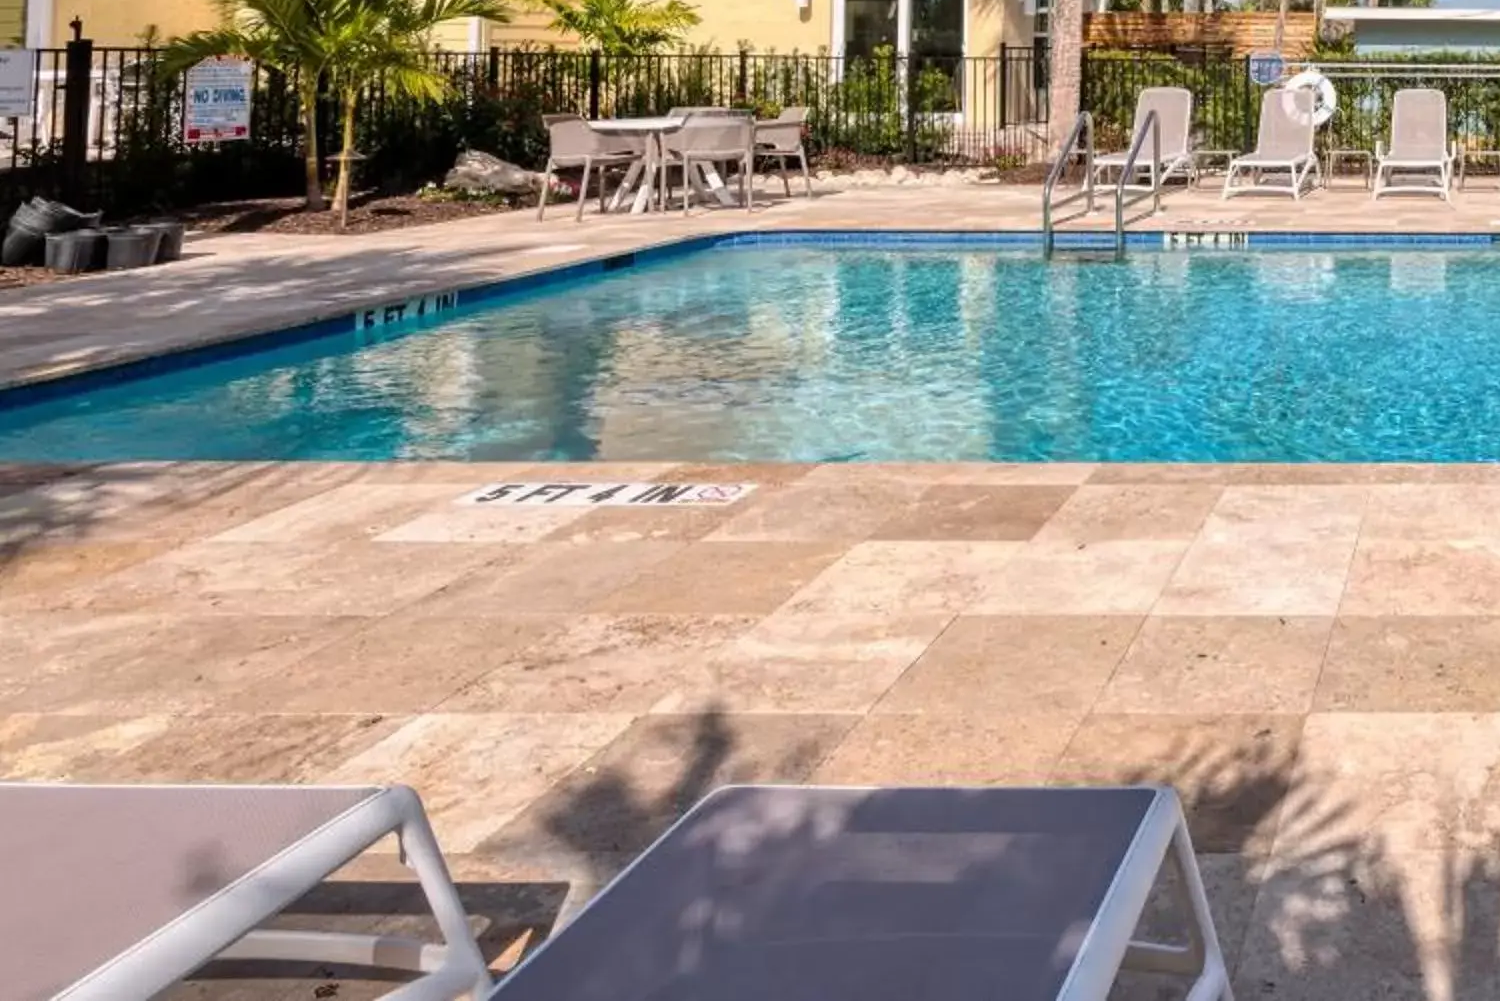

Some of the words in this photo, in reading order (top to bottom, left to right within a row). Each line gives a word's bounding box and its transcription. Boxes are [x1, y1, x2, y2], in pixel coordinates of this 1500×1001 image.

[193, 88, 209, 103] NO
[213, 88, 245, 102] DIVING
[1186, 231, 1205, 245] FT
[1228, 231, 1246, 245] IN
[384, 303, 406, 324] FT
[436, 293, 455, 311] IN
[475, 484, 526, 503] 5
[514, 484, 593, 503] FT
[586, 484, 630, 503] 4
[628, 484, 694, 503] IN
